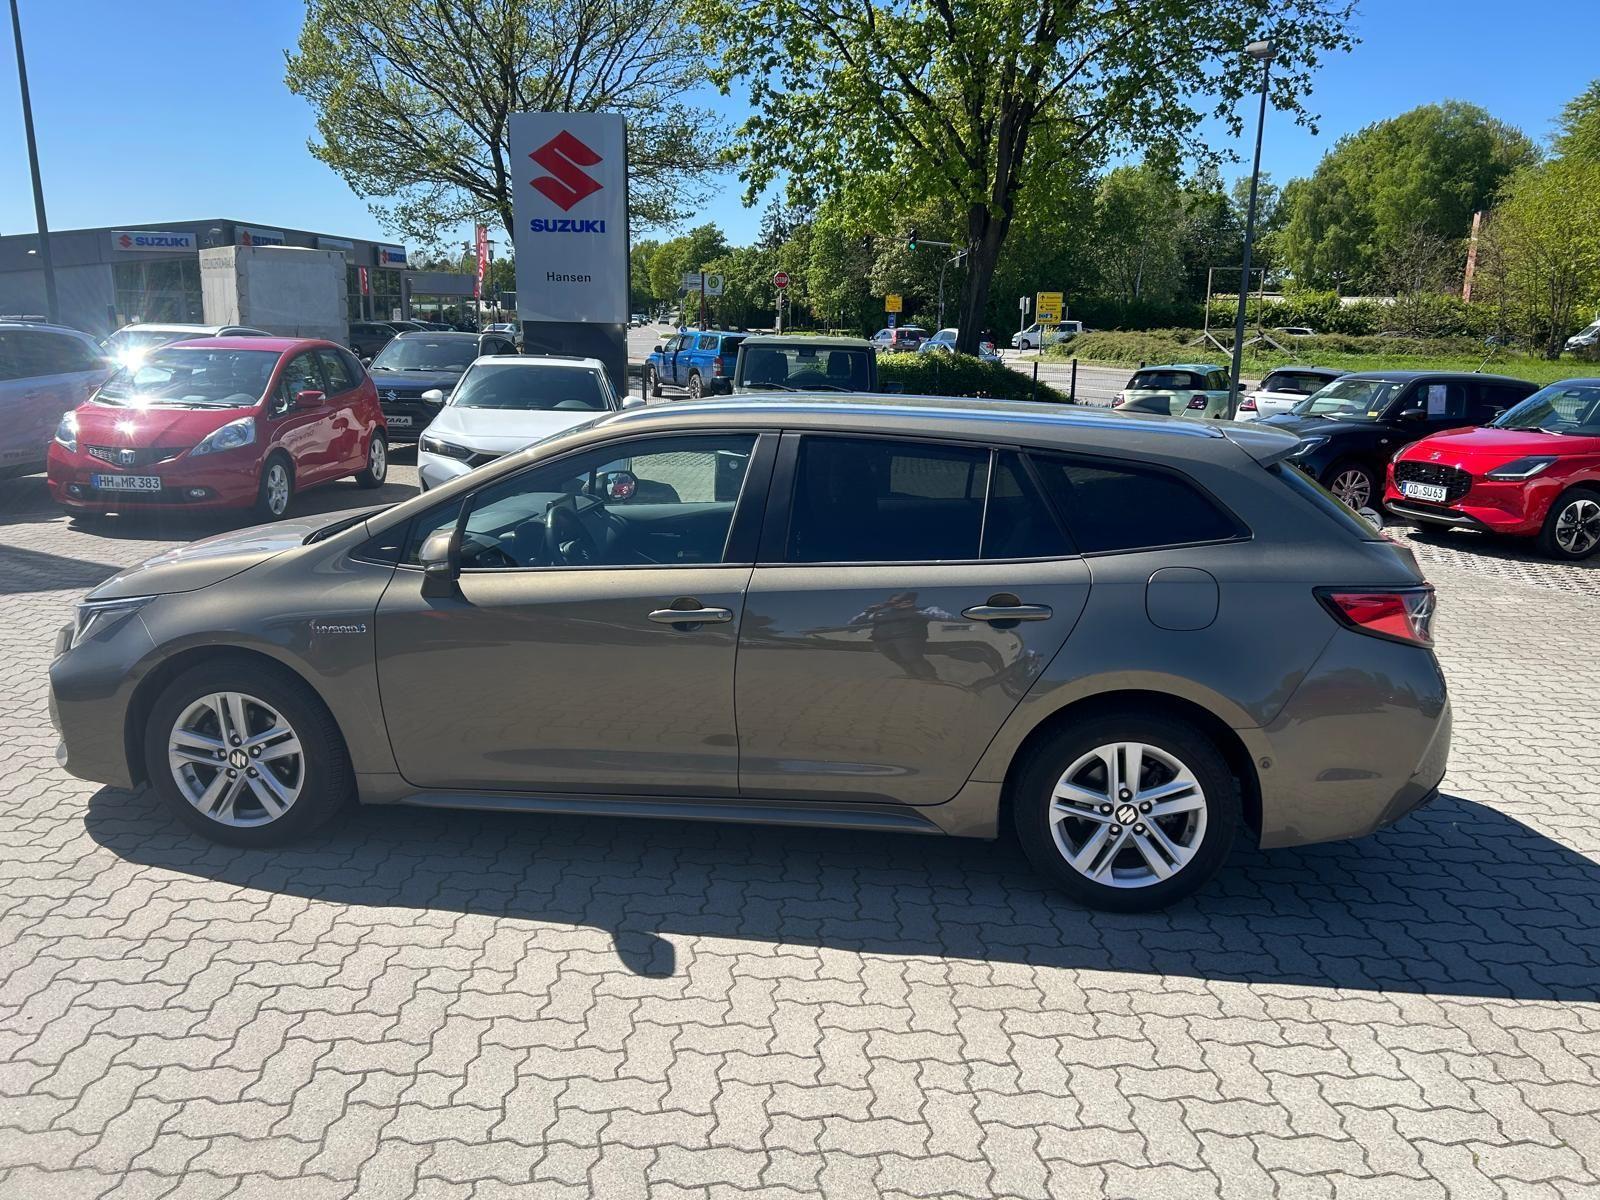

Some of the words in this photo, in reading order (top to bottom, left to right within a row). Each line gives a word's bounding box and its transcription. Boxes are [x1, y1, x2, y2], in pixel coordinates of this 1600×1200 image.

[530, 218, 606, 233] SUZUKI
[135, 236, 189, 248] SUZUKI
[546, 271, 591, 283] Hansen
[775, 276, 788, 284] STOP
[99, 476, 114, 487] HH
[121, 477, 137, 488] MR
[138, 477, 160, 489] 383
